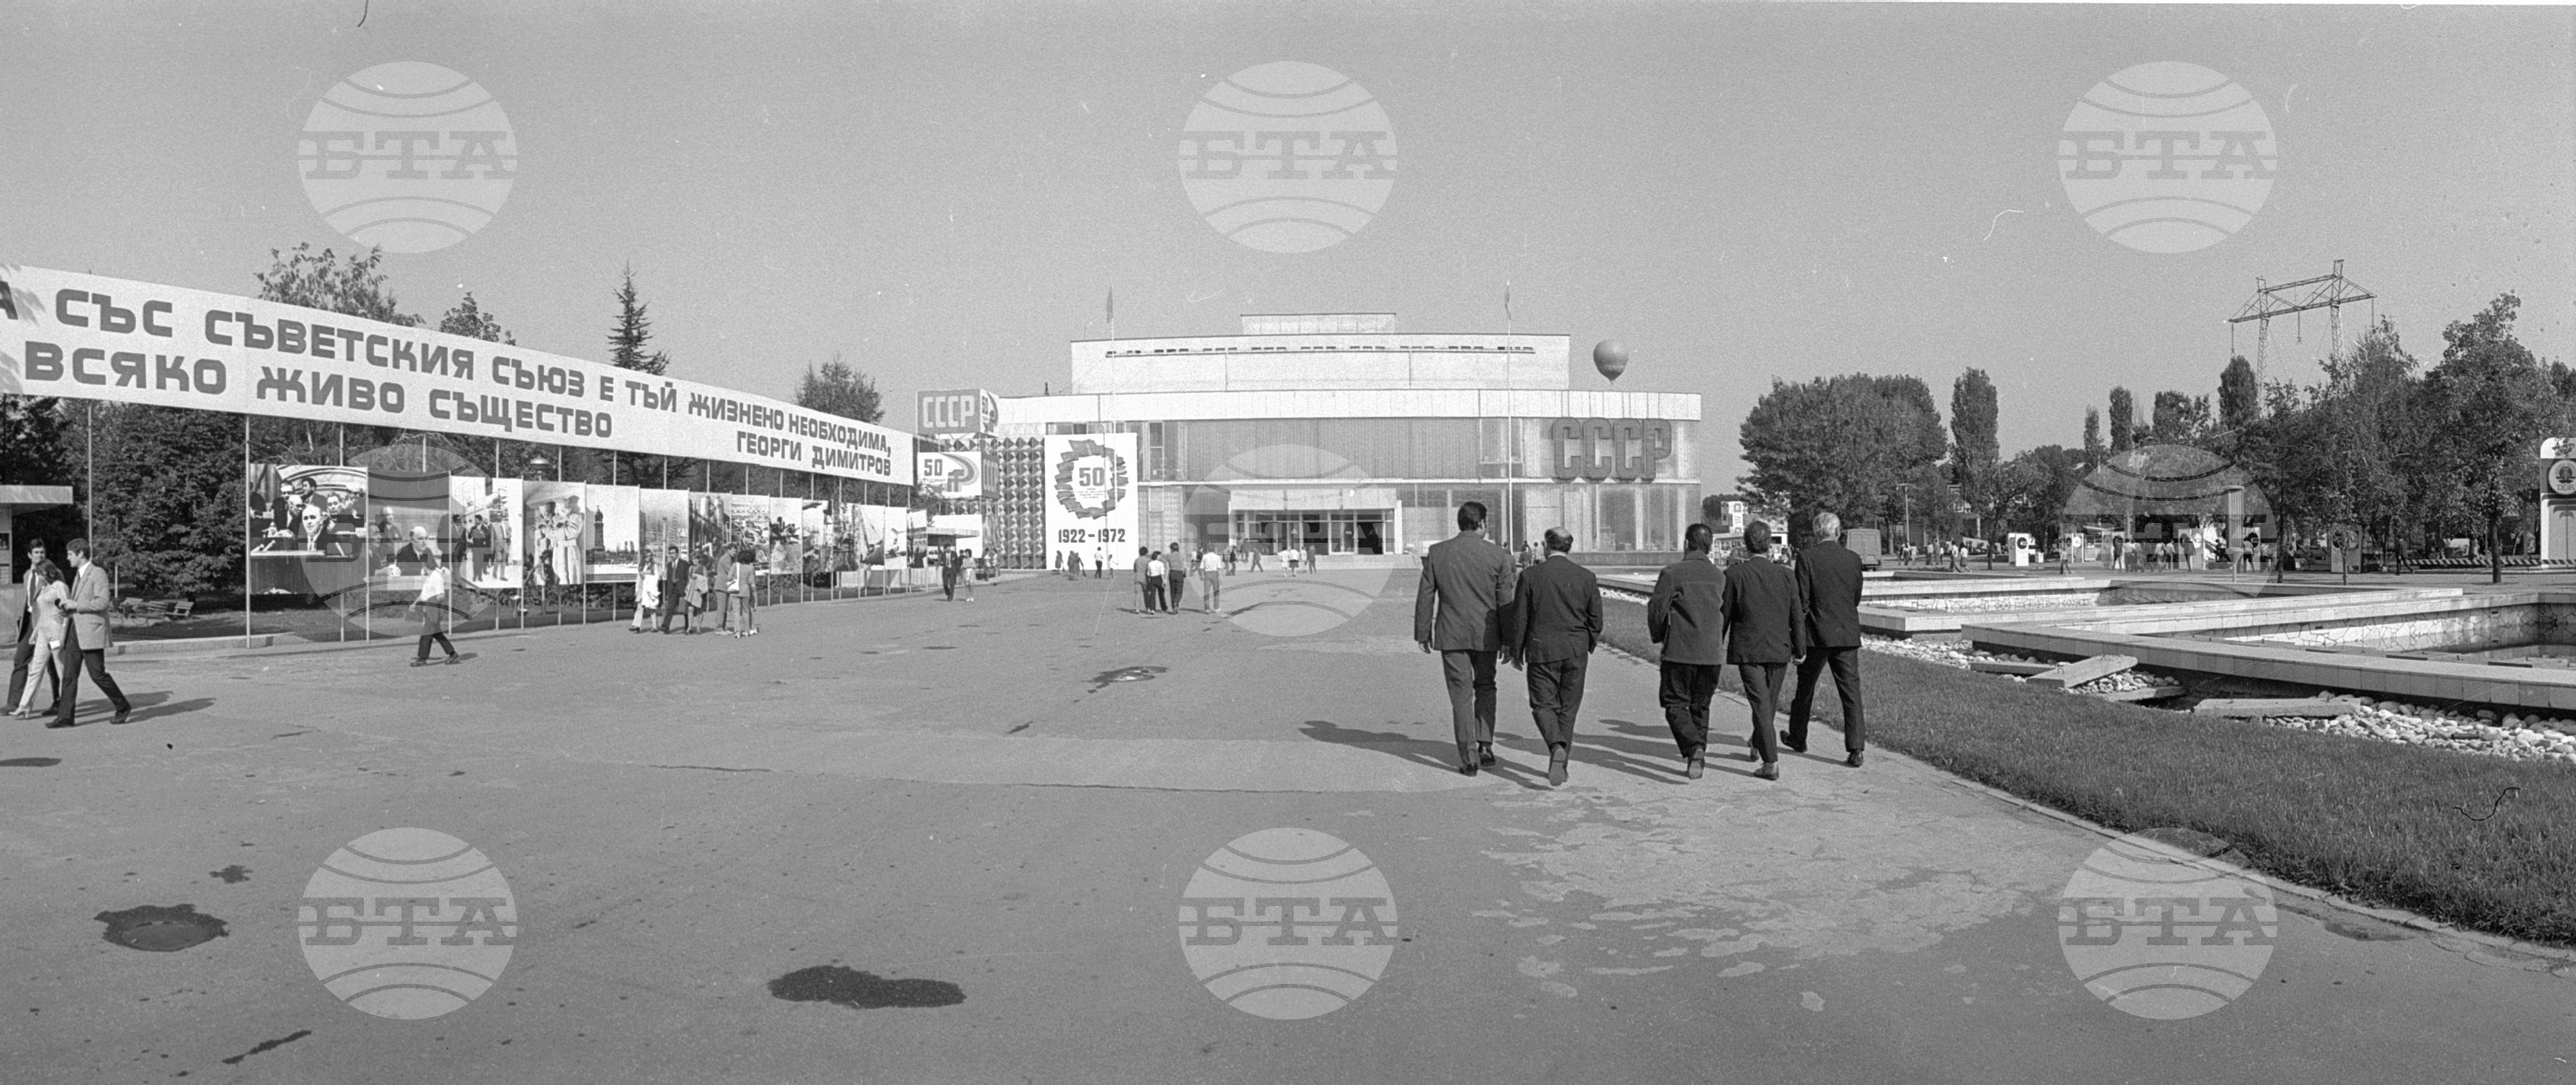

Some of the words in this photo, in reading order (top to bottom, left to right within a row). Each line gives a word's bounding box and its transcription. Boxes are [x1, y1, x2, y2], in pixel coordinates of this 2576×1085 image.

[25, 341, 226, 395] ВСЯКО
[256, 366, 404, 413] ЖИВО
[429, 388, 612, 438] СЪЩЕСТВО
[55, 288, 173, 337] СЪС
[205, 310, 474, 381] СЪВЕТСКИЯ
[492, 356, 585, 397] СЪЮЗ
[600, 375, 614, 402] Е
[625, 381, 677, 413] ТЪЙ
[688, 393, 784, 430] ЖИЗНЕНО
[789, 413, 891, 456] НЕОБХОДИМА,
[923, 395, 975, 428] СССР
[737, 431, 801, 461] ГЕОРГИ
[812, 446, 891, 476] ДИМИТРОВ
[924, 458, 943, 476] 50
[1551, 417, 1672, 480] СССР
[1079, 467, 1106, 487] 50
